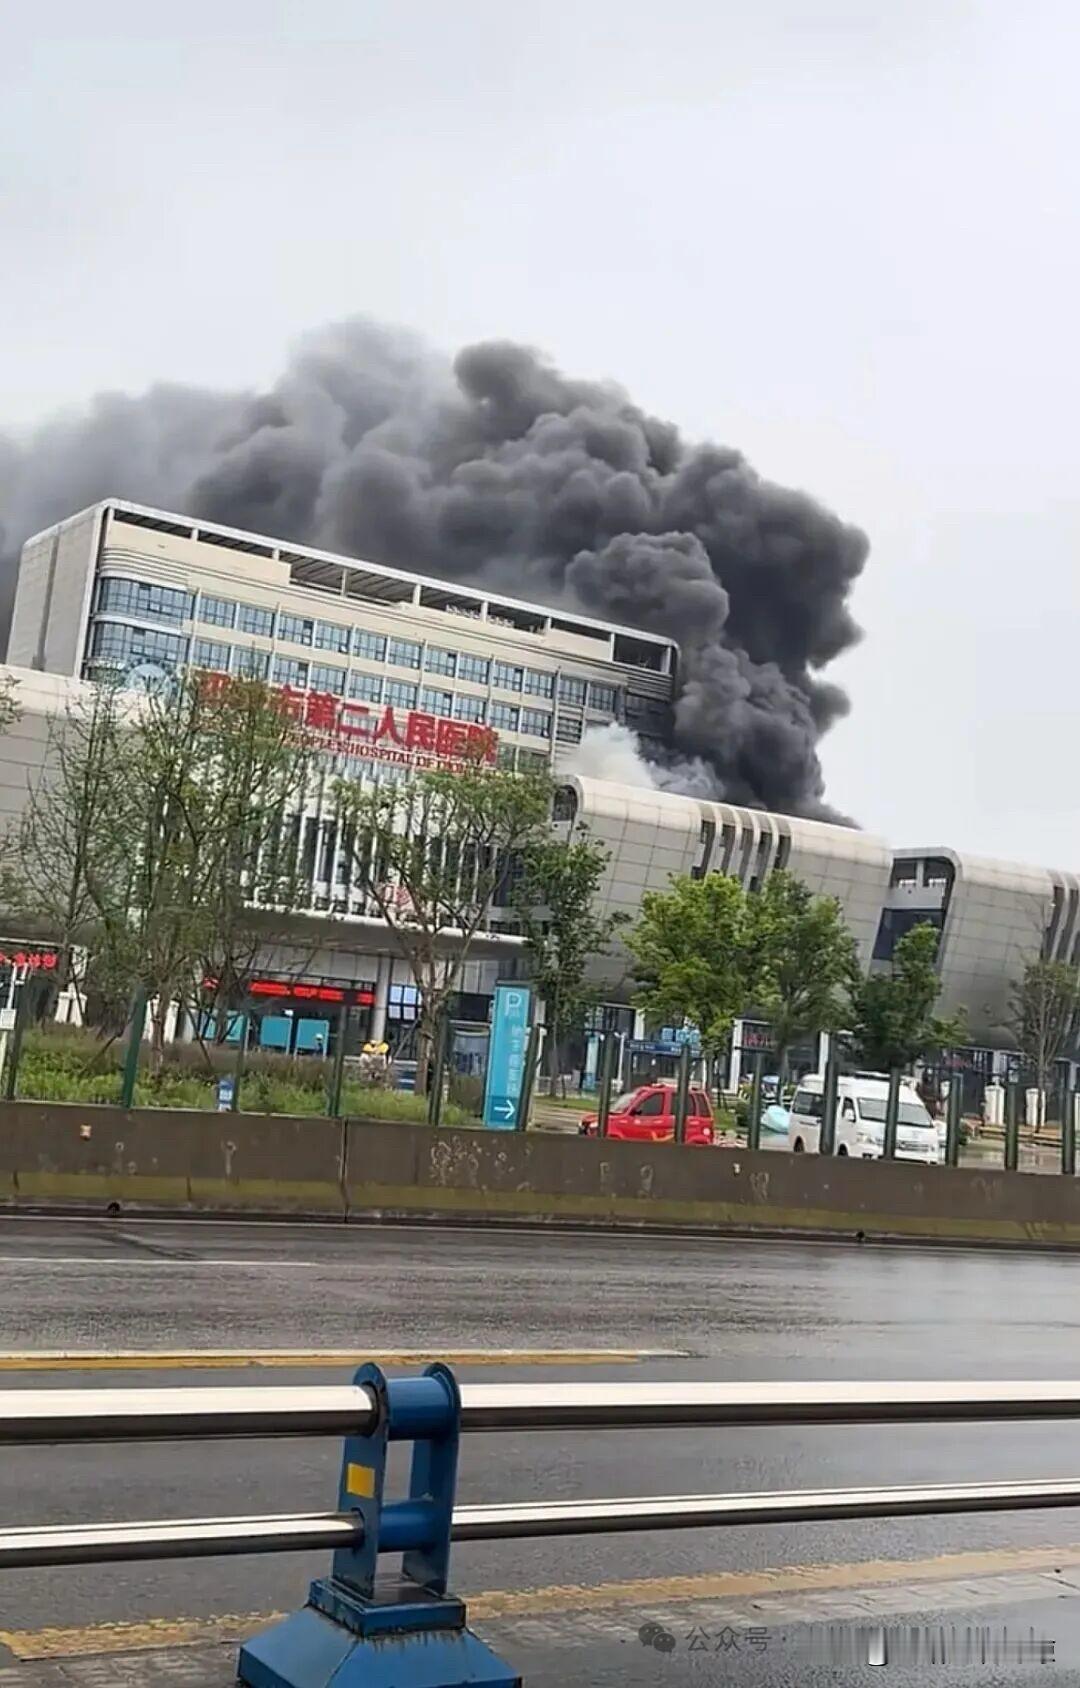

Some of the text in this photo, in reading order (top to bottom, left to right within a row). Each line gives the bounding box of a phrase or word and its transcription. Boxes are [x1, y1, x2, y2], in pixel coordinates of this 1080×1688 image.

[196, 670, 498, 763] 市第二人民医院
[504, 991, 522, 1017] P
